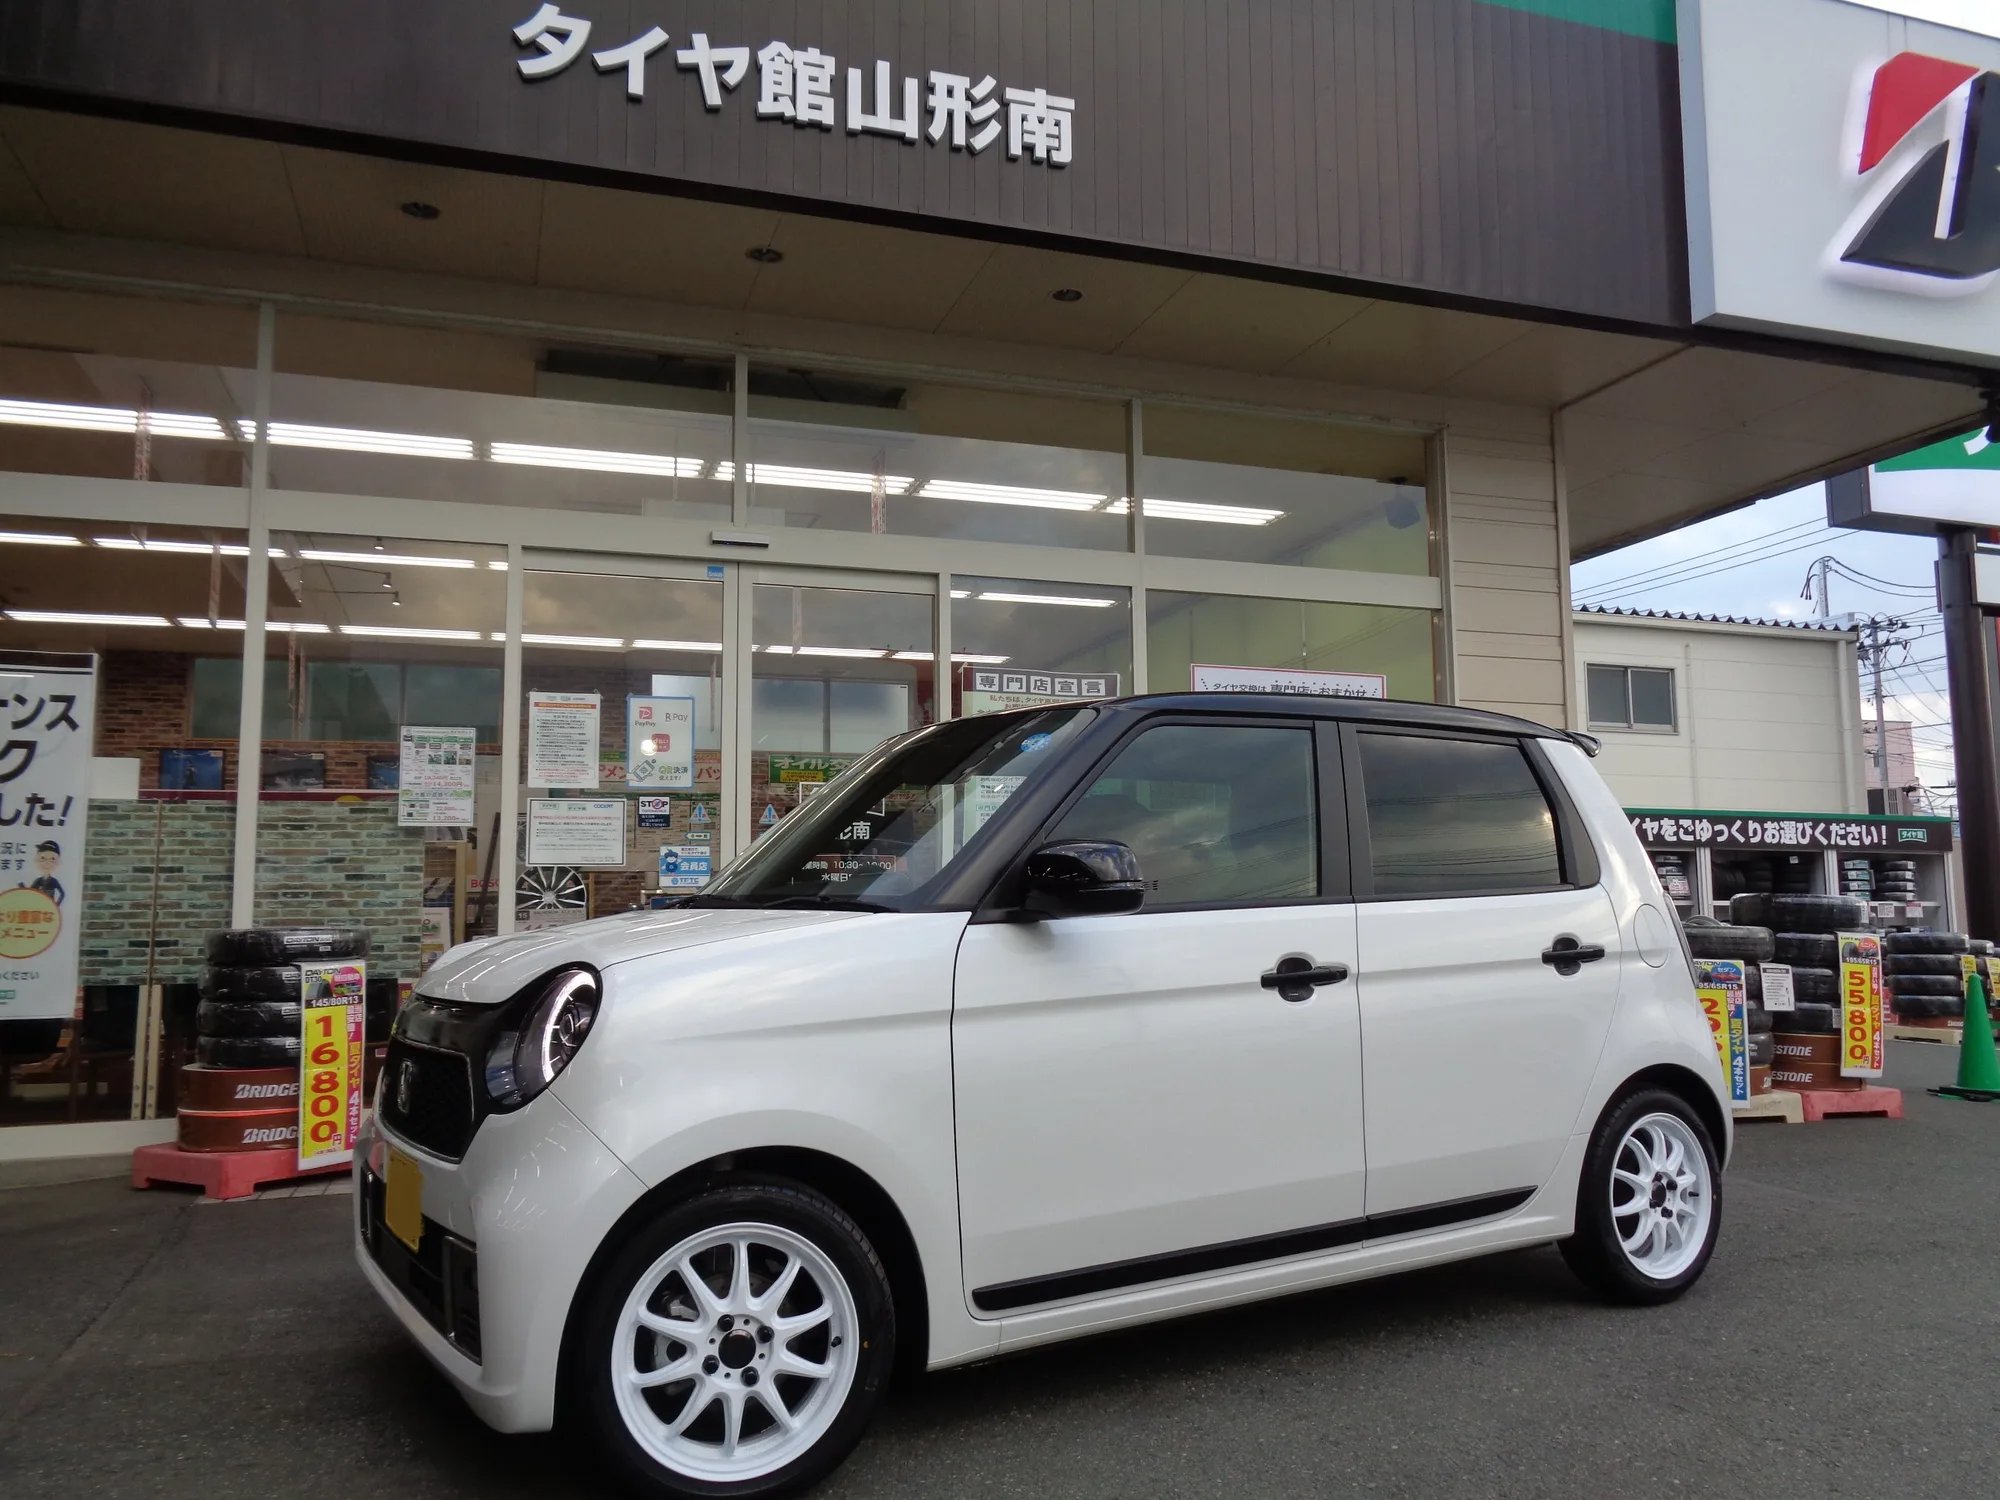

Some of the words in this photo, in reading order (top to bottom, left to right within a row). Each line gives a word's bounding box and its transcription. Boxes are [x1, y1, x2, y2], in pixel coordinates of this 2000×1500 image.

[512, 2, 1077, 168] タイヤ館山形南
[978, 674, 1102, 694] 専門店宣言
[0, 693, 80, 732] ンス
[673, 713, 688, 722] Pay
[658, 765, 688, 775] QR決済
[679, 861, 708, 872] 会員店
[802, 861, 828, 870] 業時間
[821, 873, 852, 882] 水曜日
[304, 967, 342, 977] DAYTON
[310, 996, 359, 1008] 145/80R13
[348, 1091, 361, 1143] 4本セット
